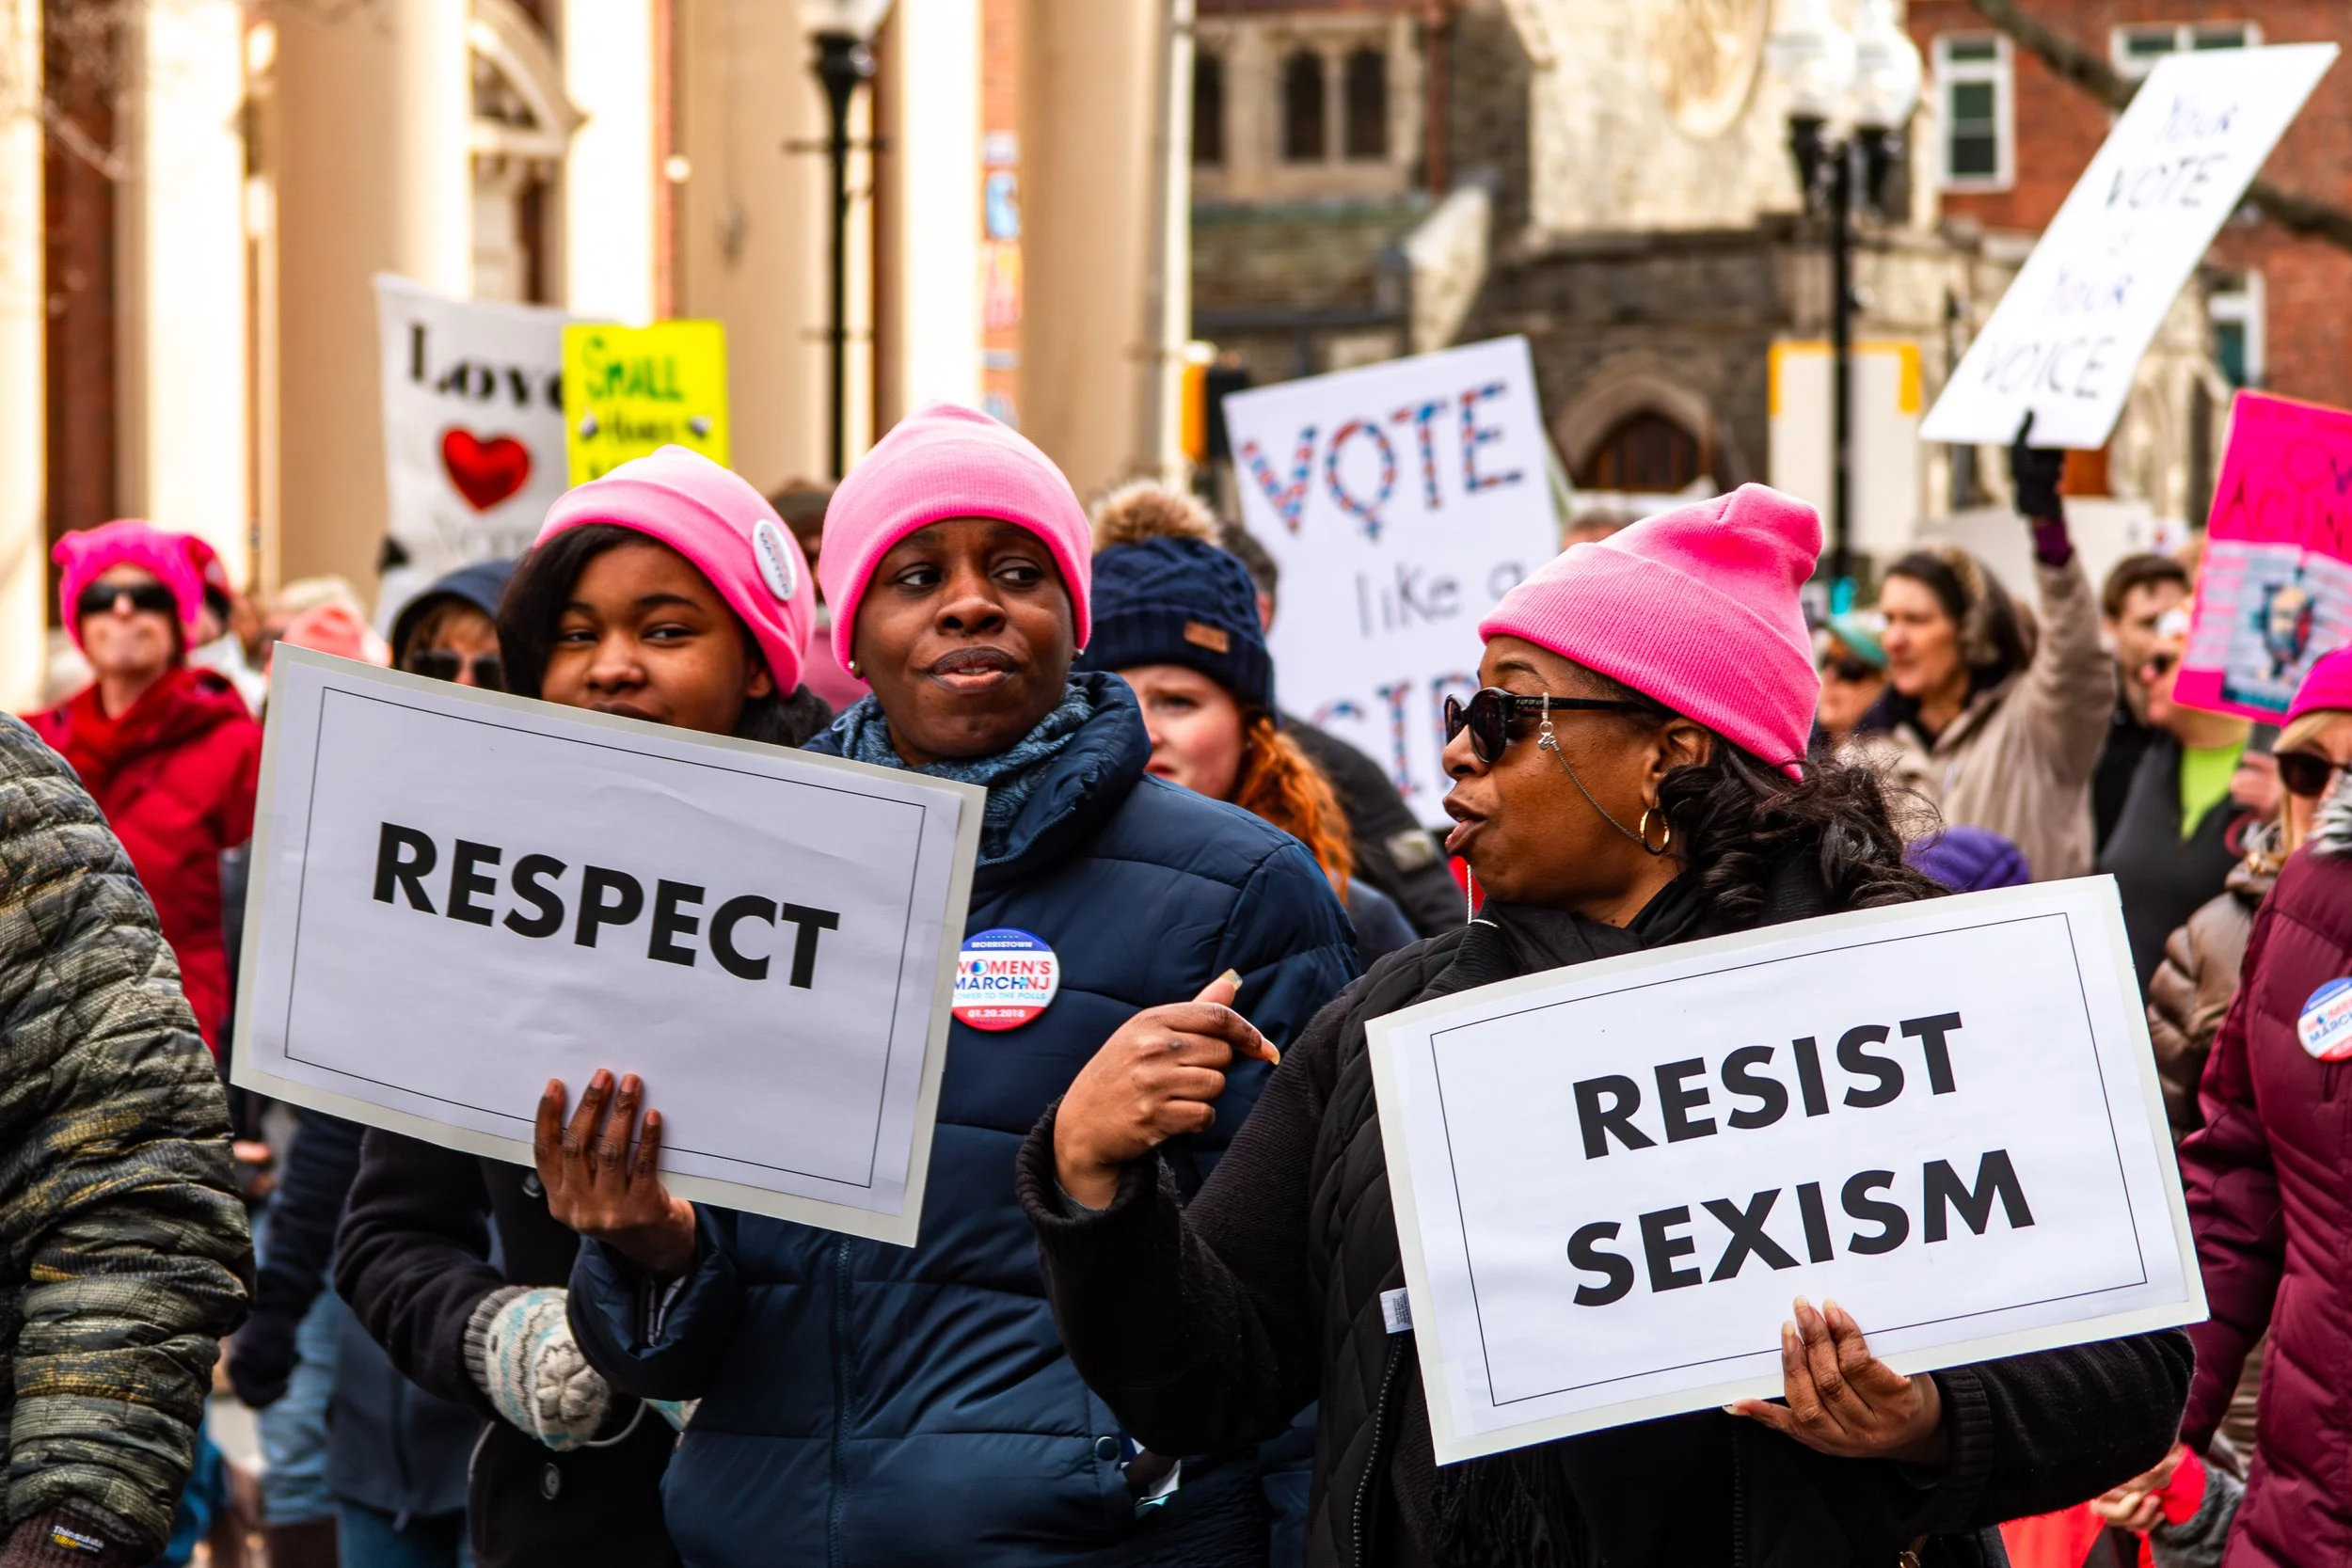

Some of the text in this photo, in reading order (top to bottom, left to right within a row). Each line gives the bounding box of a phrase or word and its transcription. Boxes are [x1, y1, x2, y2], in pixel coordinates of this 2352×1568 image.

[2106, 152, 2229, 209] VOTE
[1983, 339, 2116, 400] VOICE
[1242, 383, 1523, 543] VOTE
[373, 821, 840, 990] RESPECT
[970, 941, 1033, 949] MORRISTOWN
[967, 1008, 1026, 1019] 01.20.2018
[2310, 1011, 2352, 1043] MARC
[1572, 1011, 1963, 1160] RESIST
[1566, 1148, 2035, 1307] SEXISM
